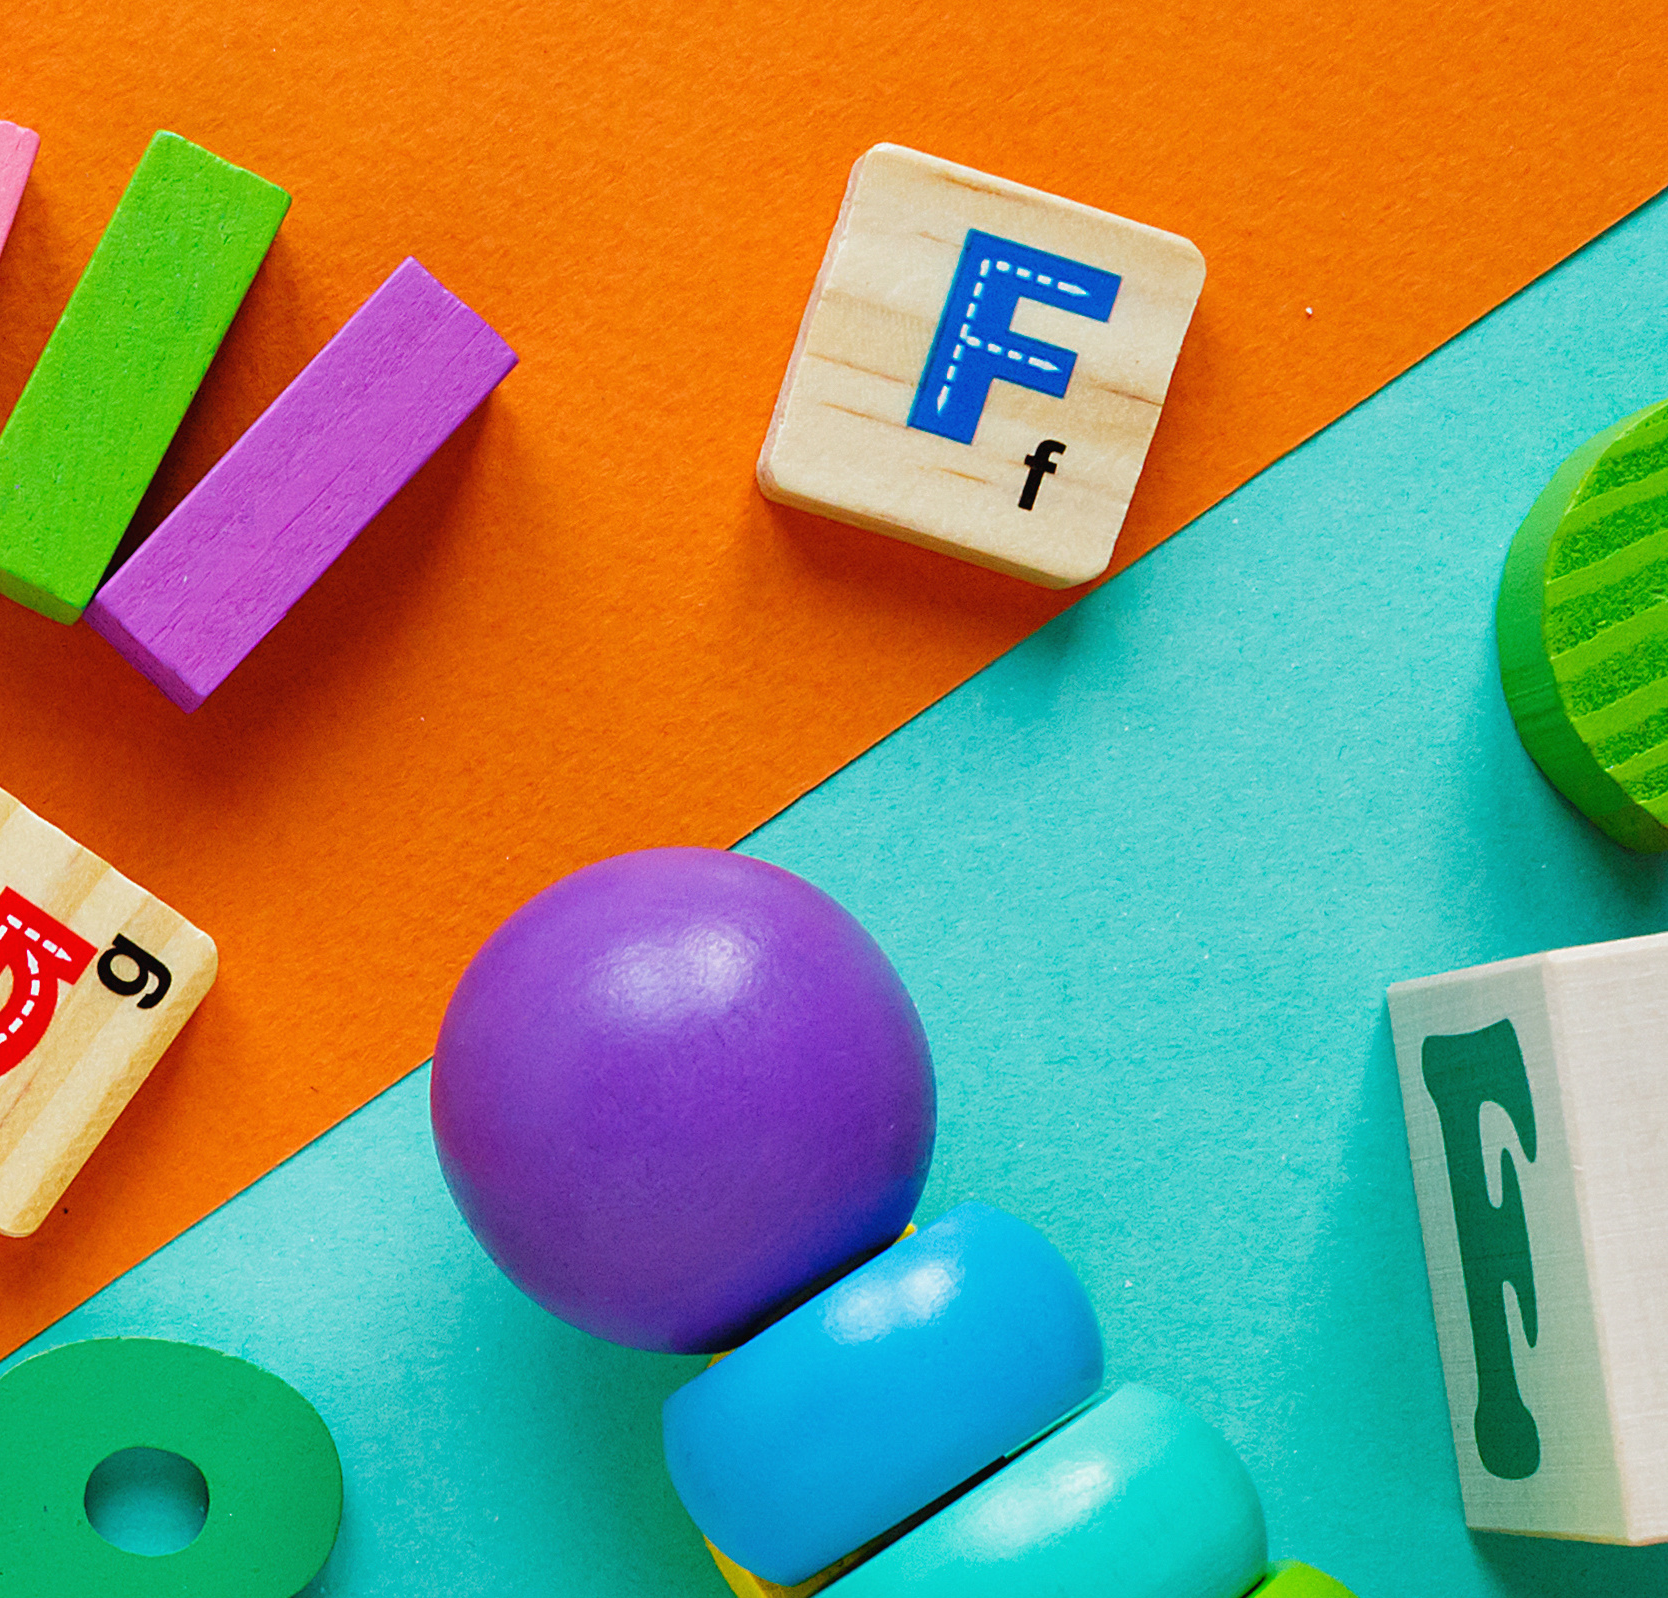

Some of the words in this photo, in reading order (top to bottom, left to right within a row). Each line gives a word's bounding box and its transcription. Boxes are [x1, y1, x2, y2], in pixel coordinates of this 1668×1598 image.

[907, 229, 1121, 445] F
[1019, 440, 1066, 510] f
[98, 934, 171, 1008] g
[1420, 1017, 1541, 1481] F
